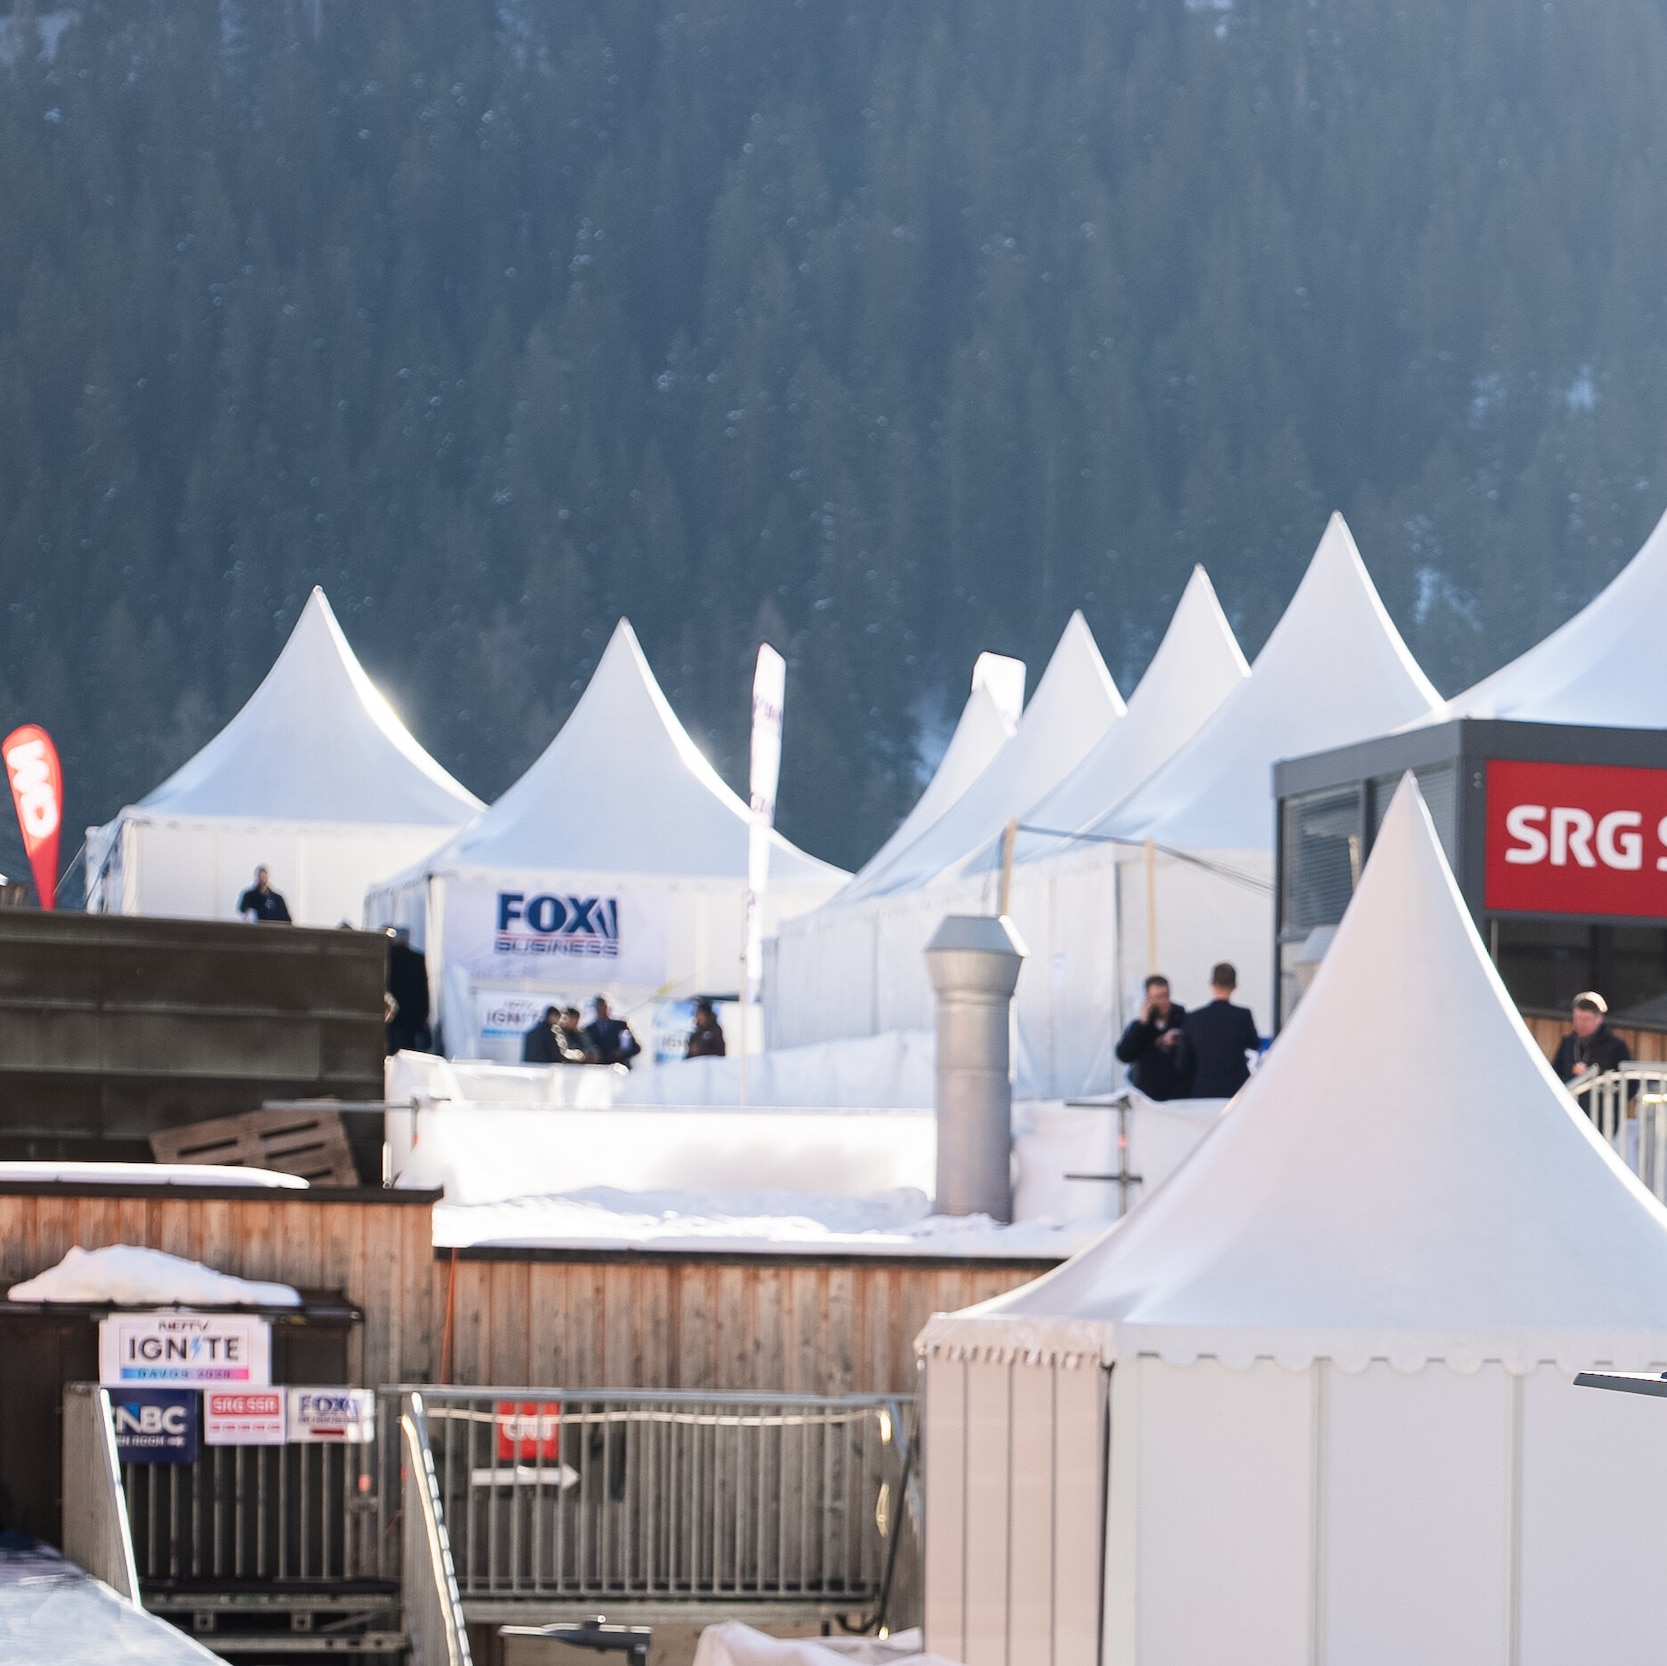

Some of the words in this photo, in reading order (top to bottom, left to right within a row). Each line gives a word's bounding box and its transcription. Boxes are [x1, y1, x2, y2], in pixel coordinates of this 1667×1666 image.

[1505, 804, 1643, 871] SRG
[497, 892, 617, 938] FOX
[495, 938, 619, 956] BUSINESS
[128, 1336, 240, 1361] IGNITE
